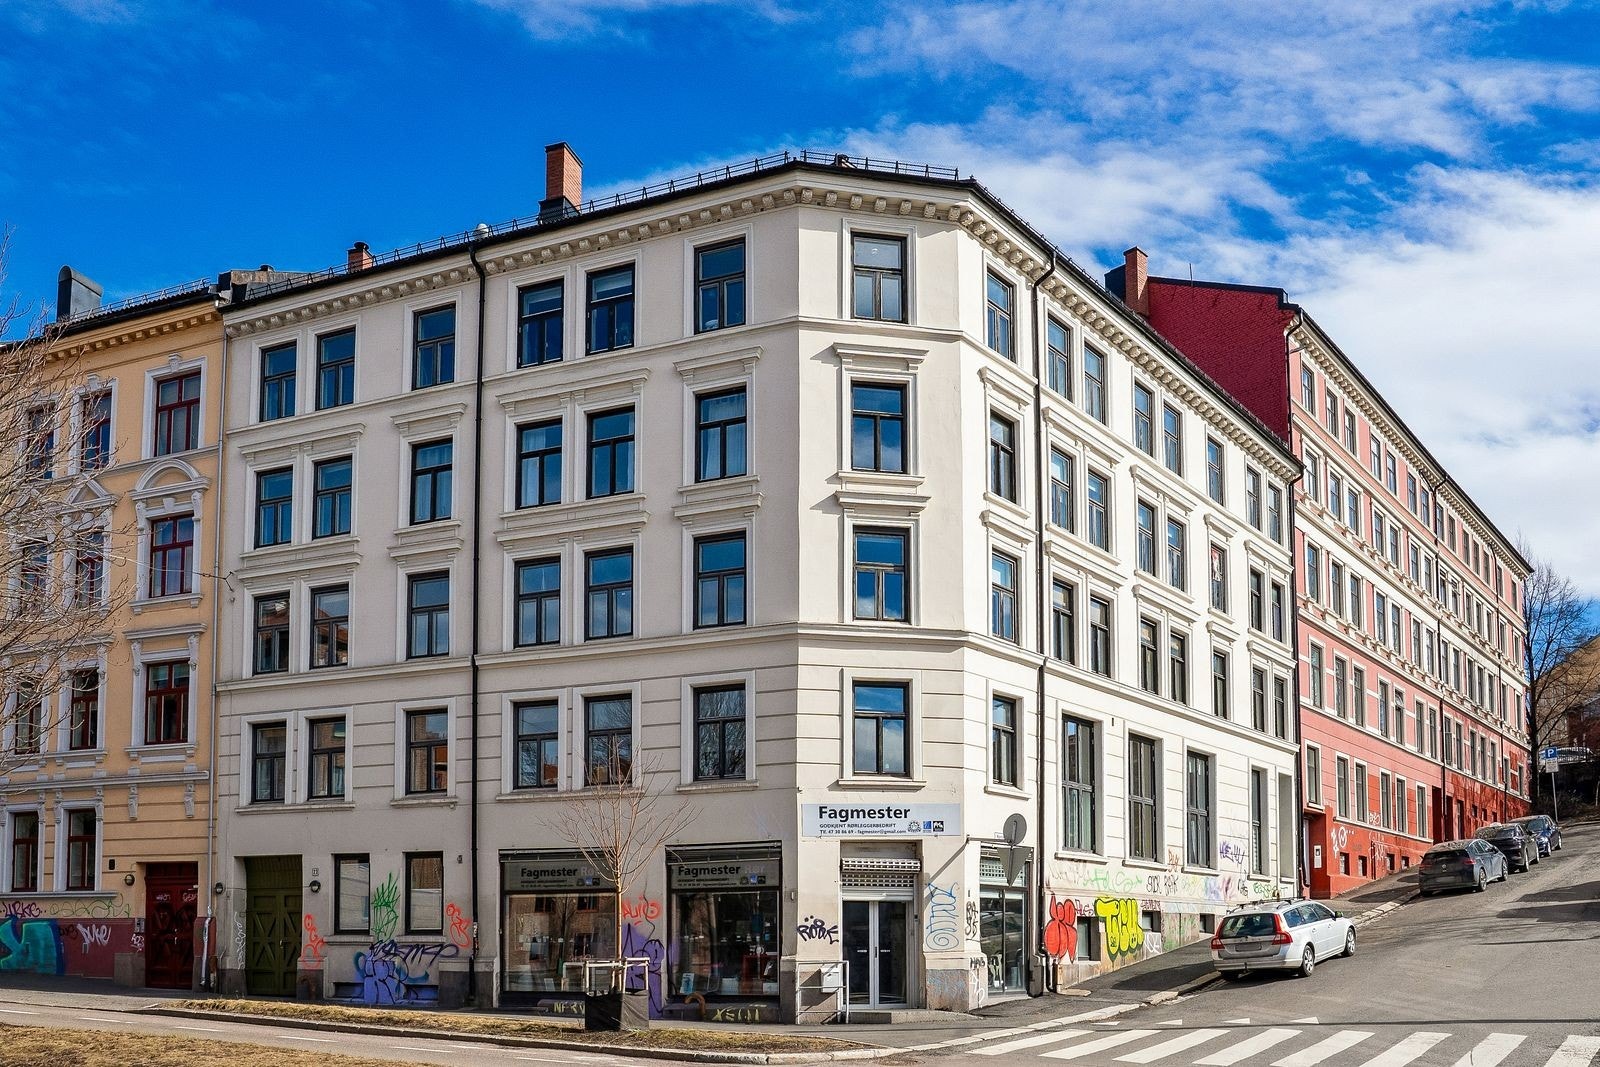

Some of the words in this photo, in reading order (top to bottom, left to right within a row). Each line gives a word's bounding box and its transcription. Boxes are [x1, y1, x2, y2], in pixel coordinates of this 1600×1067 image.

[1548, 749, 1554, 757] P
[819, 806, 910, 822] Fagmester
[521, 867, 578, 879] Fagmester
[678, 865, 741, 878] Fagmester
